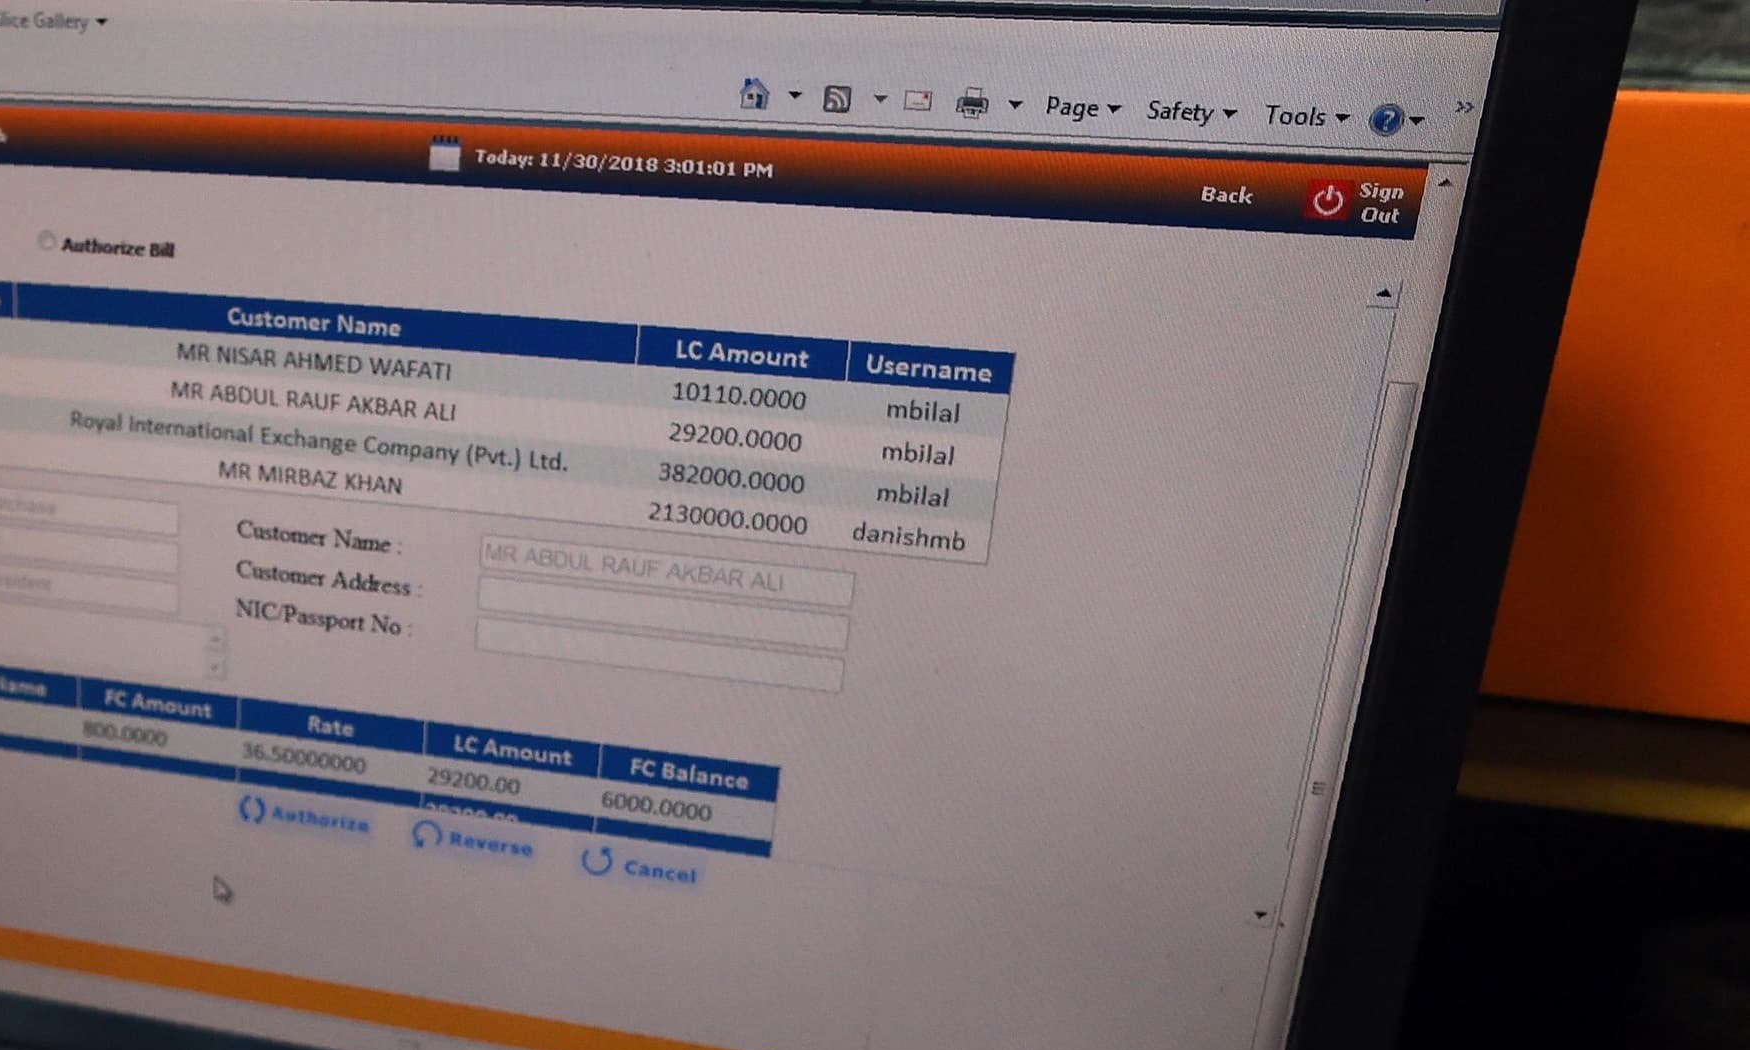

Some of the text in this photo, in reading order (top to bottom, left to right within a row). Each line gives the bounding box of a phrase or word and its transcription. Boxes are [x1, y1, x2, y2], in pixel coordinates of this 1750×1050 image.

[33, 13, 88, 33] Gallery
[1046, 95, 1100, 122] Page
[1147, 100, 1214, 127] Safety
[1266, 104, 1327, 126] Tools
[475, 148, 775, 179] Today: 11/30/2018 3:01:01 PM
[1200, 186, 1253, 205] Back
[1359, 181, 1405, 203] Sign
[1361, 206, 1401, 225] Out
[61, 236, 175, 260] Authorize Bill
[226, 306, 401, 338] Customer Name
[176, 342, 452, 382] MR NISAR AHMED WAFATI
[675, 339, 810, 370] LC Amount
[865, 354, 993, 384] Username
[170, 380, 456, 422] MR ABDUL RAUF AKBAR ALI
[672, 381, 807, 411] 10110.0000
[886, 399, 961, 424] mbilal
[70, 410, 568, 473] Royal International Exchange Company (Pvt.) Ltd.
[668, 422, 802, 453] 29200.0000
[880, 440, 956, 467] mbilal
[218, 461, 404, 495] MR MIRBAZ KHAN
[658, 462, 806, 495] 382000.0000
[876, 482, 950, 508] mbilal
[647, 502, 808, 536] 2130000.0000
[236, 519, 392, 555] Customer Name
[852, 521, 966, 553] danishmb
[236, 560, 412, 598] Customer Address
[485, 543, 785, 593] MR ABDUL RAUF AKBAR ALI
[236, 599, 403, 637] NIC/Passport No
[104, 688, 213, 719] FC Amount
[82, 718, 168, 748] 800.0000
[307, 714, 355, 738] Rate
[242, 740, 368, 775] 36.50000000
[453, 732, 572, 768] LC Amount
[427, 766, 520, 797] 29200.00
[629, 757, 750, 790] FC Balance
[271, 805, 370, 835] Authorize
[601, 789, 713, 823] 6000.0000
[449, 830, 534, 859] Reverse
[623, 859, 698, 885] Cancel
